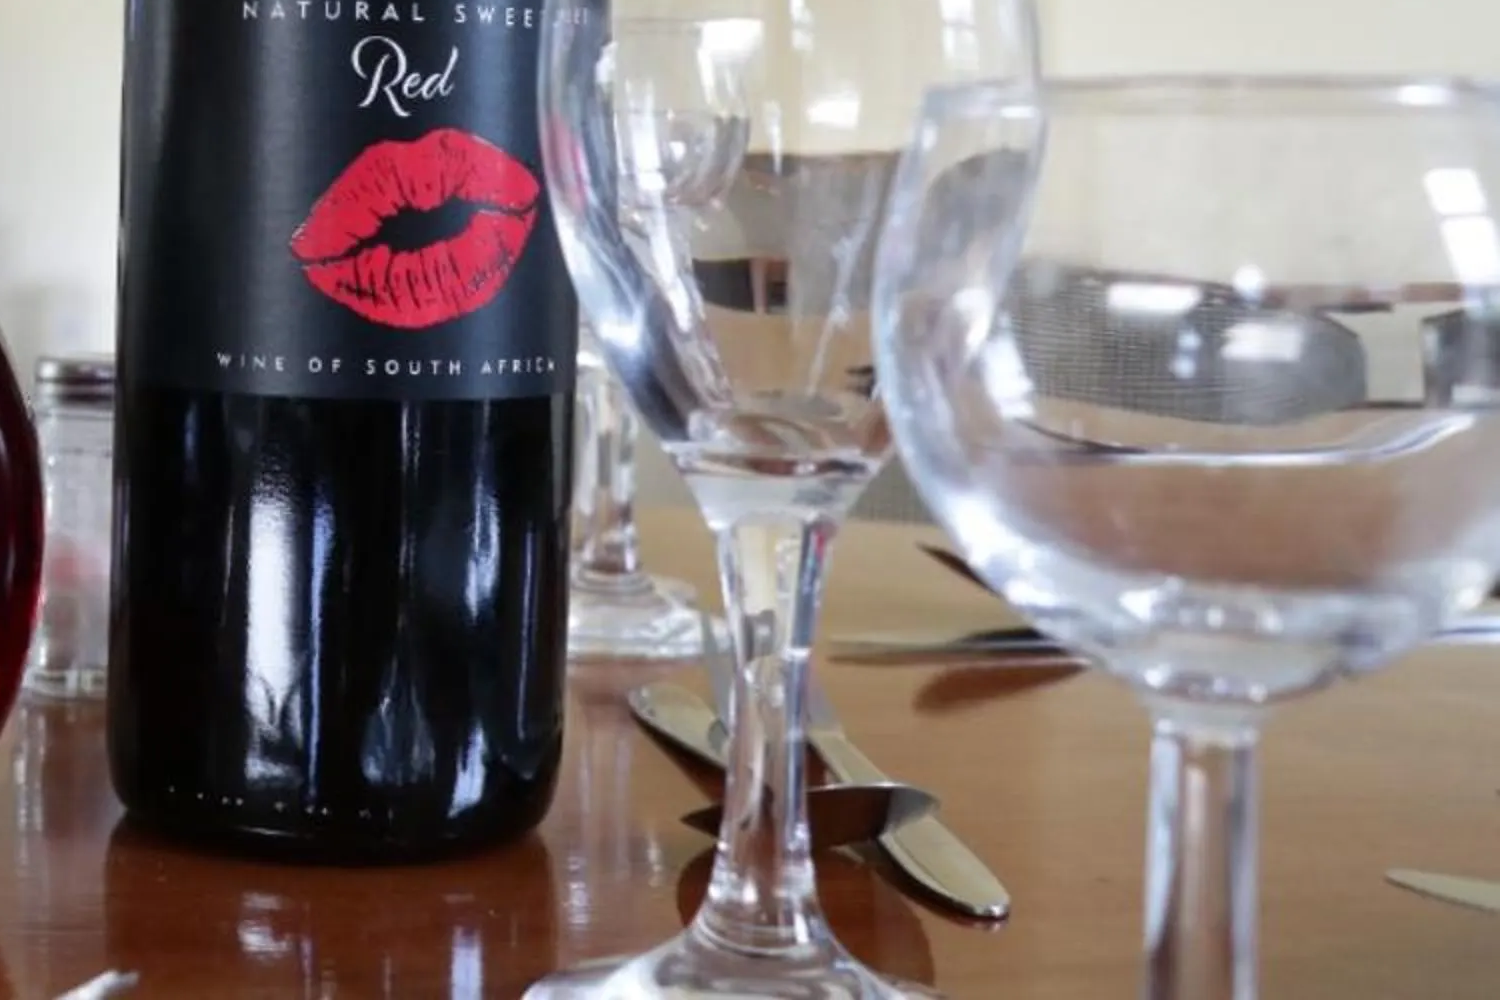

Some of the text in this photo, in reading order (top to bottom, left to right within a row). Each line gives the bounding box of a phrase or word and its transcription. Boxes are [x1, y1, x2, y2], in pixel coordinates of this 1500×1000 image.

[243, 0, 425, 21] NATURAL
[454, 3, 544, 29] SWEE
[350, 35, 460, 117] Red
[217, 352, 556, 376] WINE OF SOUTH AFRICA
